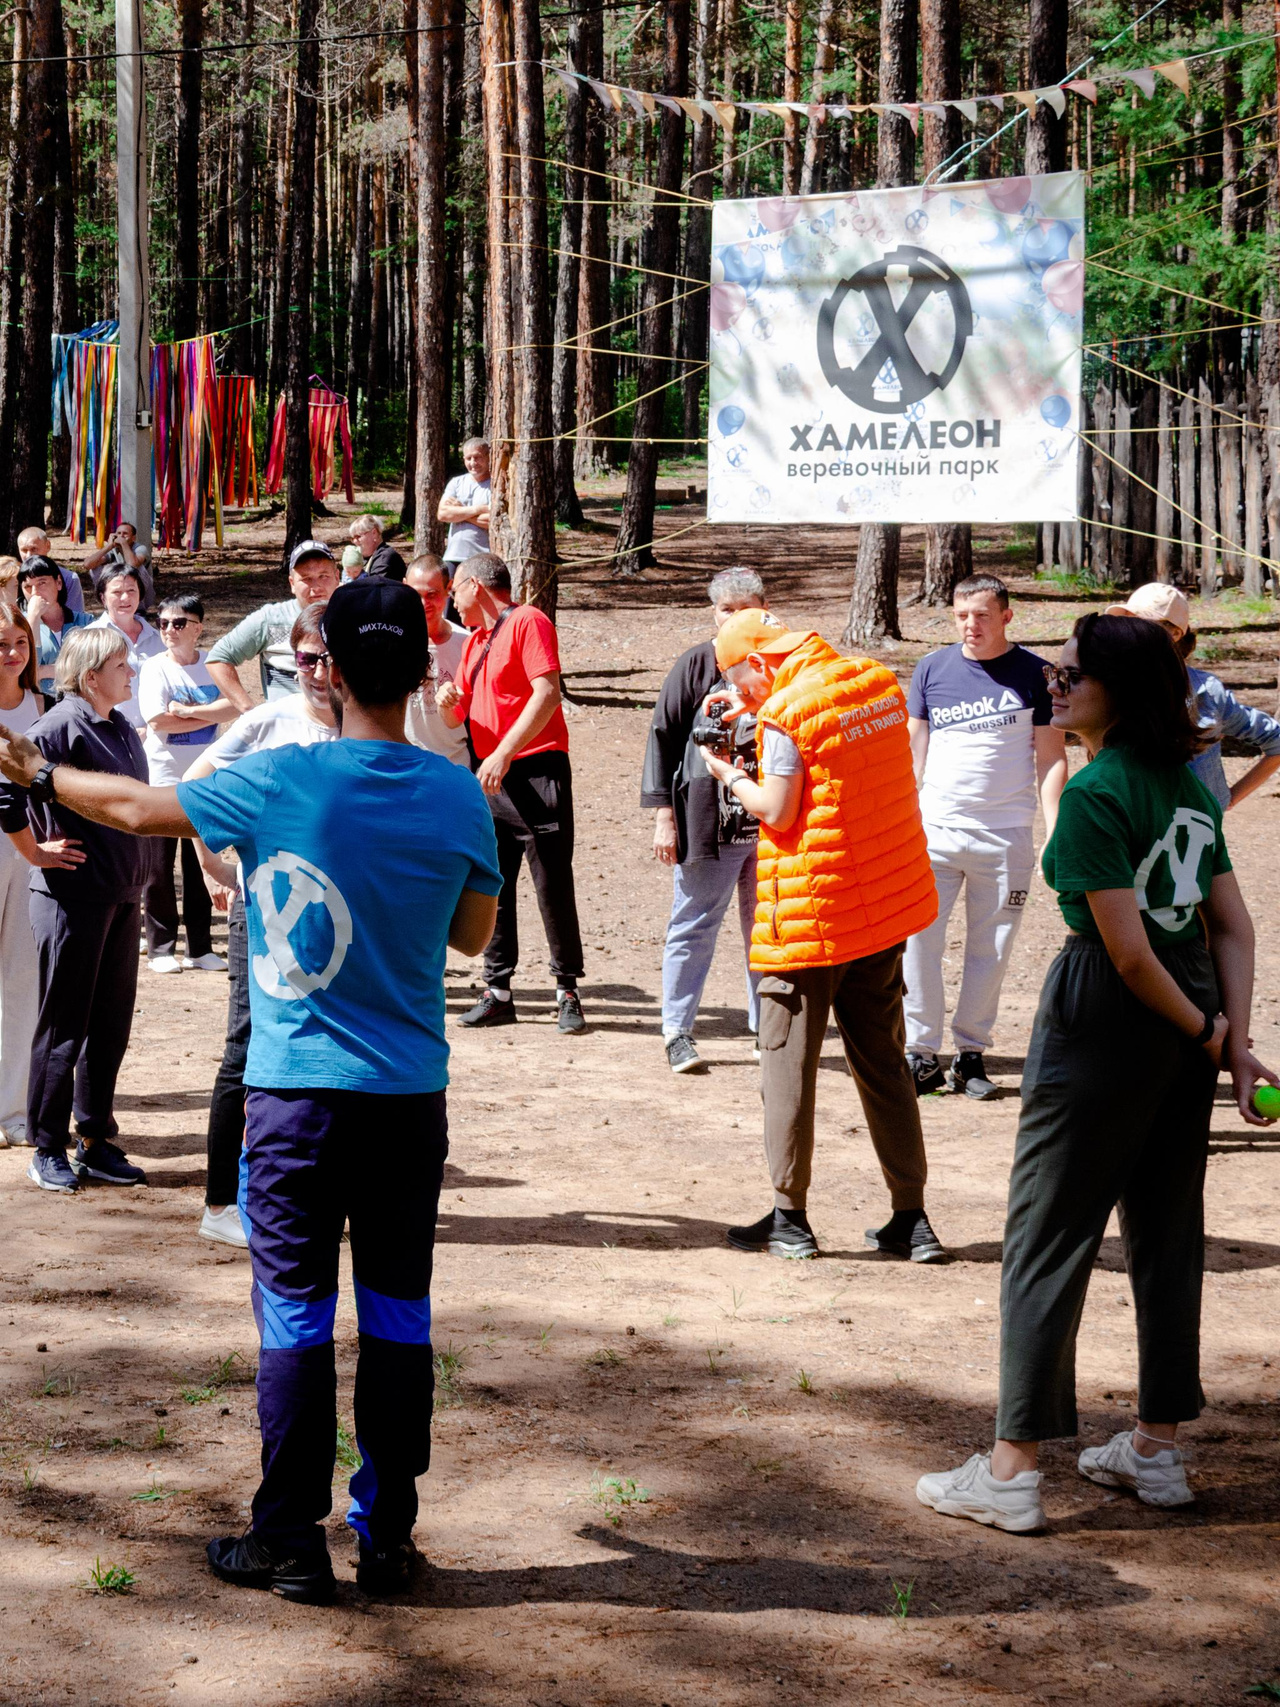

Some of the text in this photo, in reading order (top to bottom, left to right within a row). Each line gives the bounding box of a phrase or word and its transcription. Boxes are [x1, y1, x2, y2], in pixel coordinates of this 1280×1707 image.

[789, 419, 1001, 452] ХАМЕЛЕОН
[787, 455, 1000, 483] веревочный парк
[358, 622, 404, 636] МИХТАХОВ
[838, 694, 900, 728] ДРУГАЯ ЖИЗНЬ
[843, 709, 906, 743] LIFE & TRAVELS
[931, 696, 997, 727] Reebok
[969, 714, 1017, 732] CrossFit
